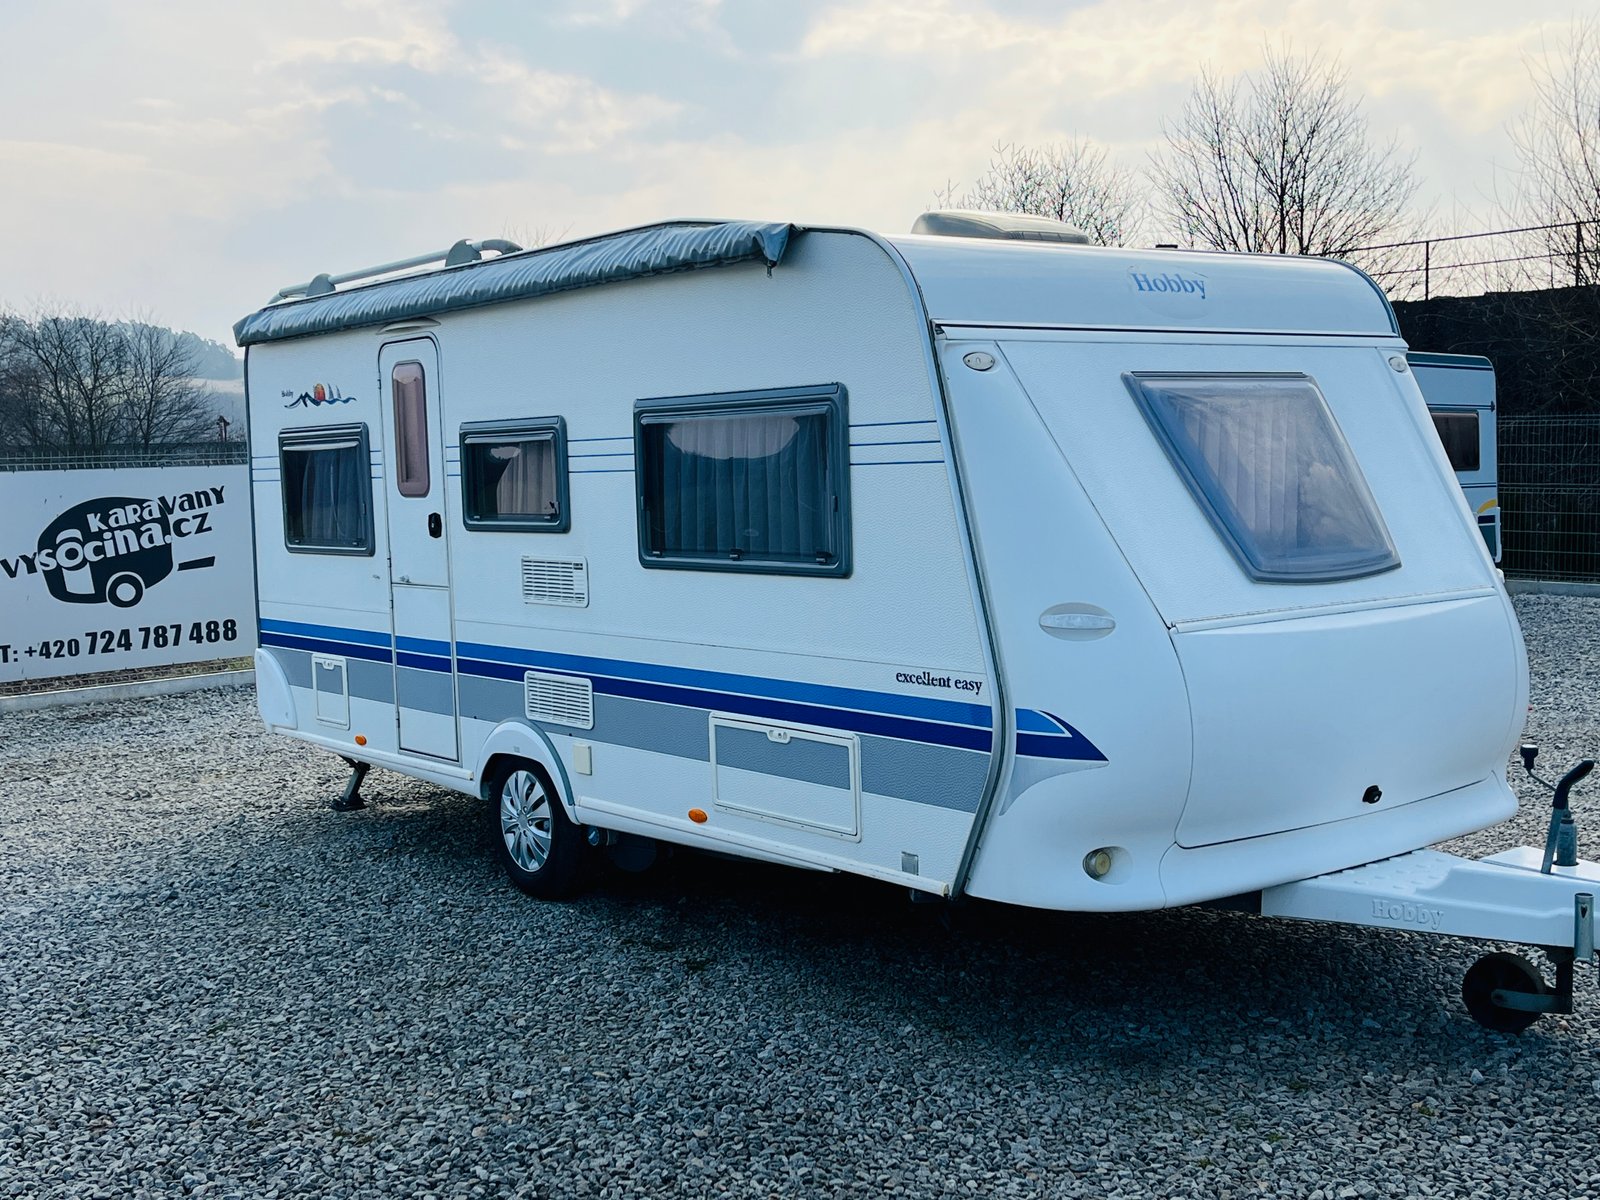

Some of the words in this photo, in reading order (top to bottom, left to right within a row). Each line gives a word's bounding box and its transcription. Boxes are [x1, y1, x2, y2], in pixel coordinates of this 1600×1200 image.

[1131, 272, 1206, 300] Hobby
[0, 645, 19, 664] T:
[24, 638, 80, 660] +420
[85, 629, 133, 655] 724
[138, 624, 182, 650] 787
[189, 619, 238, 644] 488
[895, 671, 951, 688] excellent
[954, 678, 982, 695] easy
[1371, 899, 1444, 930] Hobby
